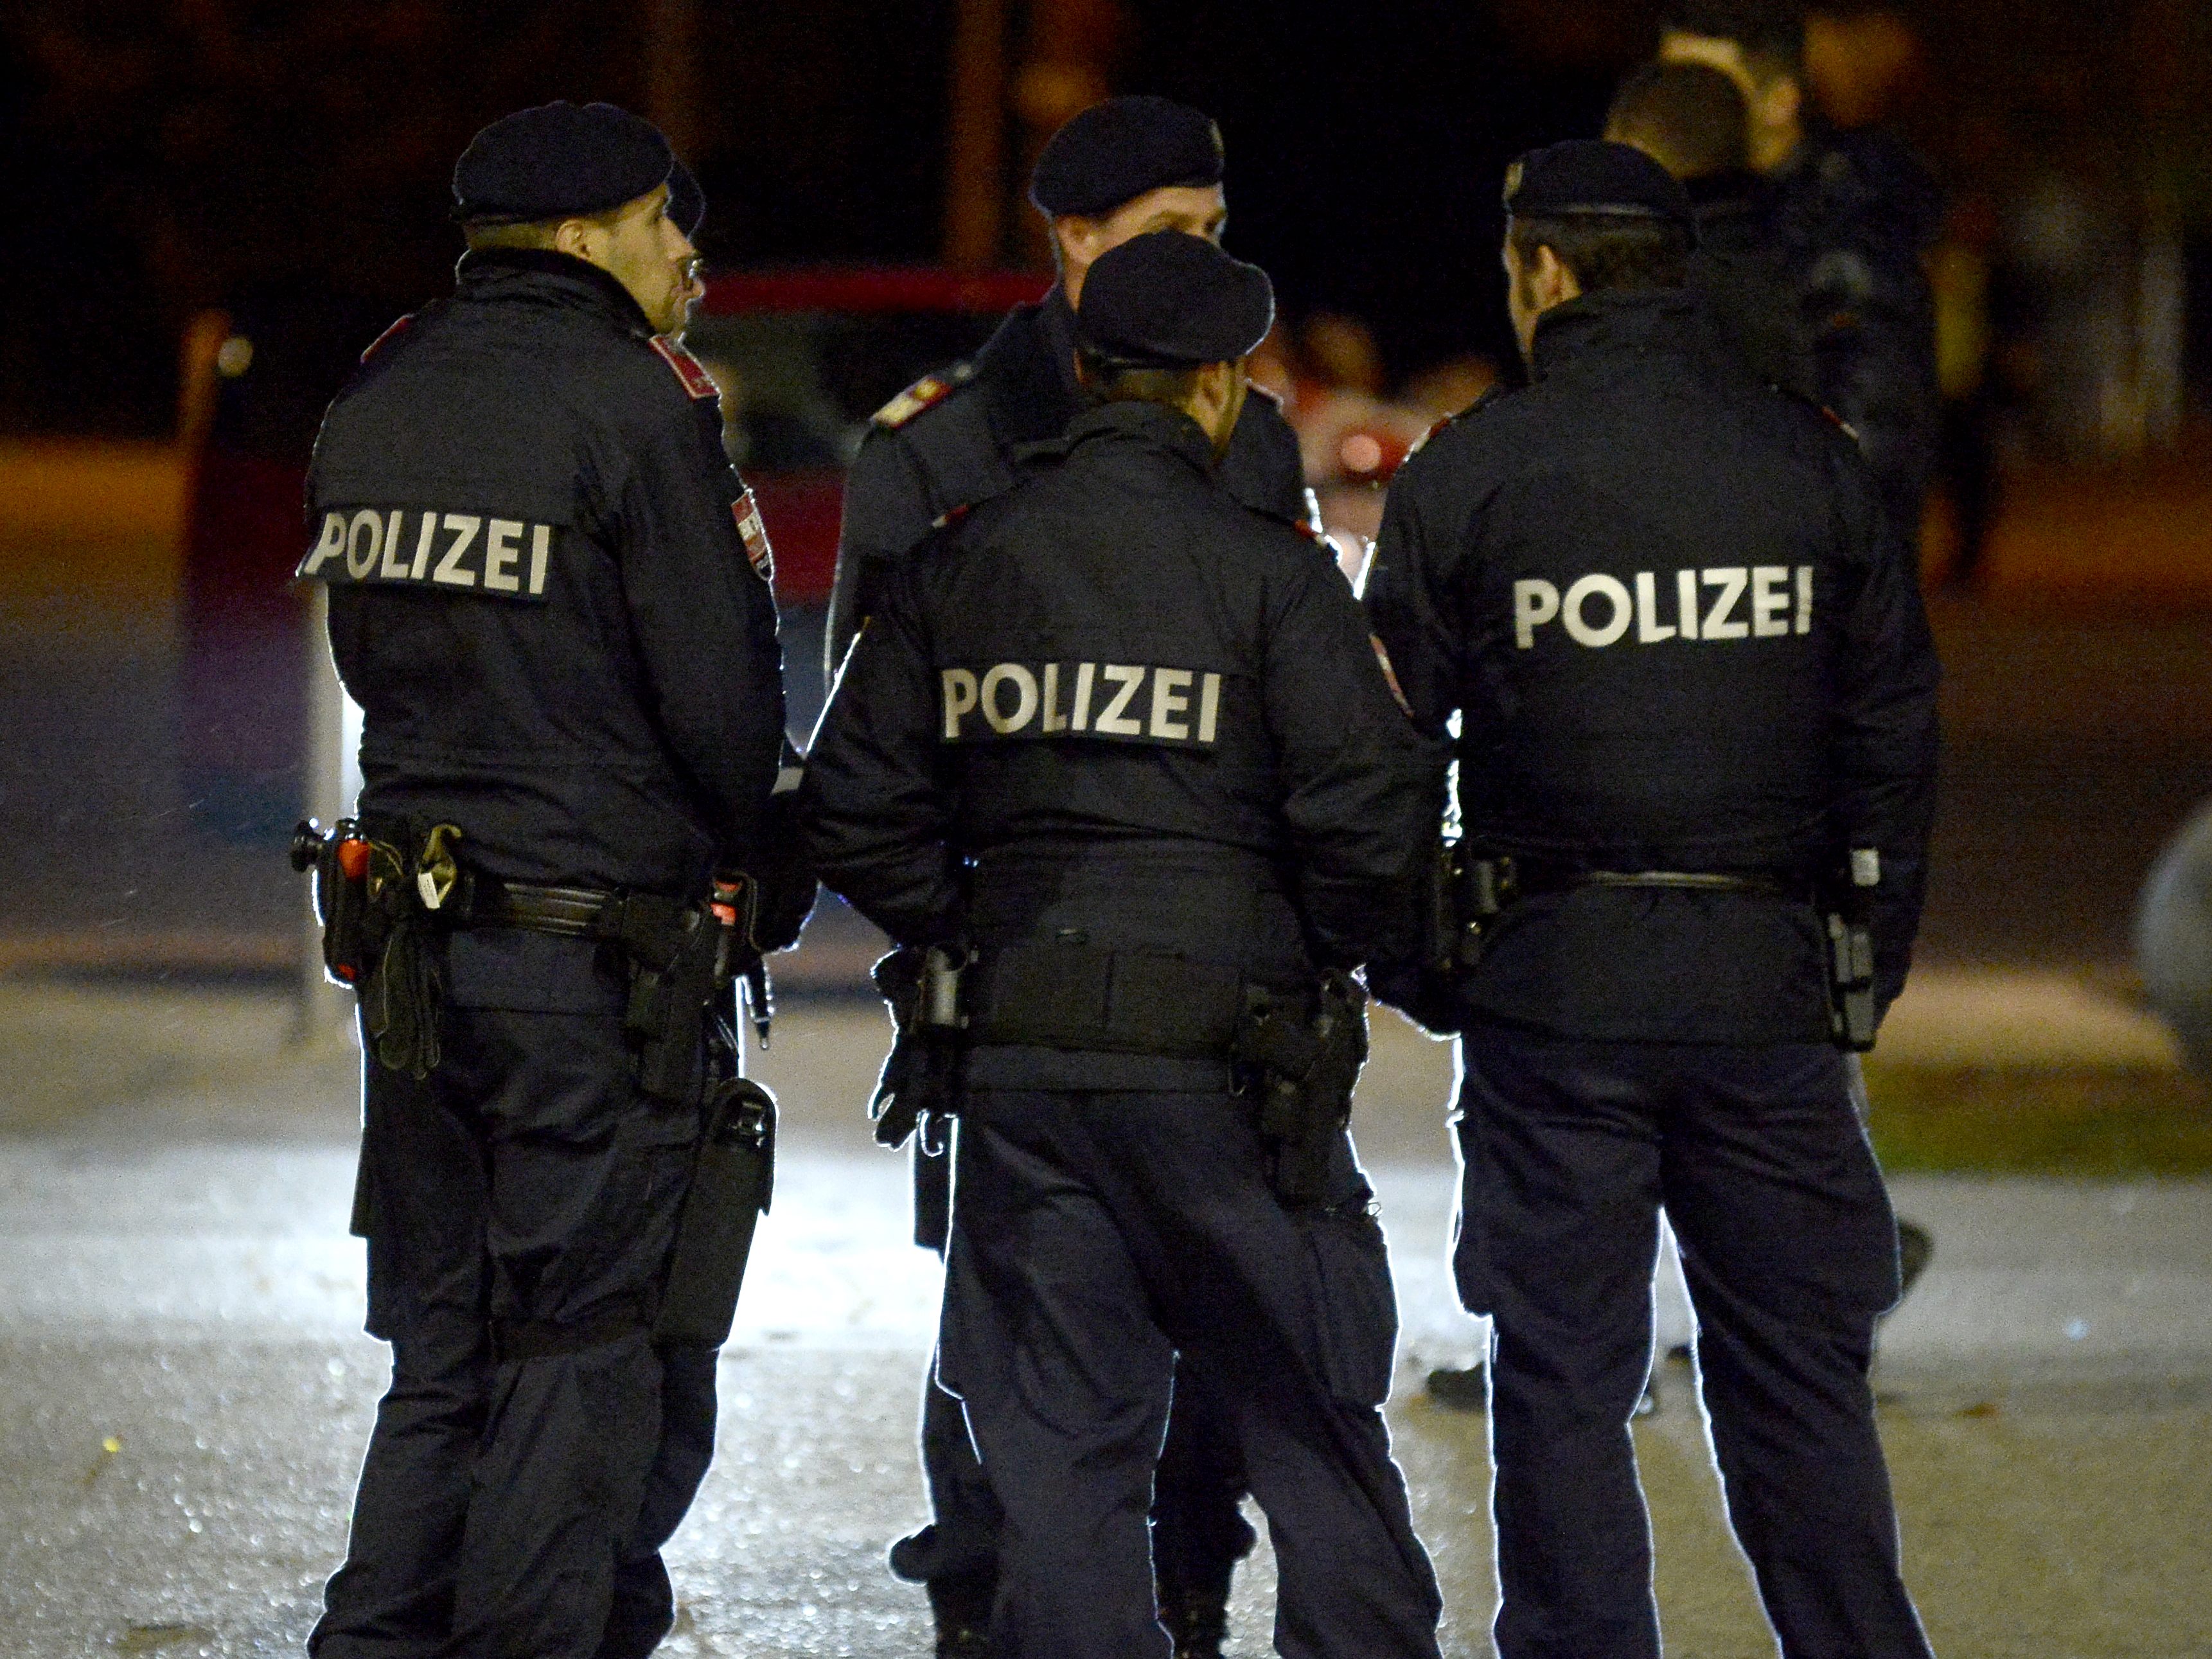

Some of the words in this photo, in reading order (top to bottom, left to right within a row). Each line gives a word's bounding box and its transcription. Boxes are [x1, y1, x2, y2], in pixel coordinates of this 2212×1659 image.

[303, 509, 551, 595] POLIZEI
[1514, 565, 1813, 650] POLIZEI
[941, 662, 1221, 743] POLIZEI
